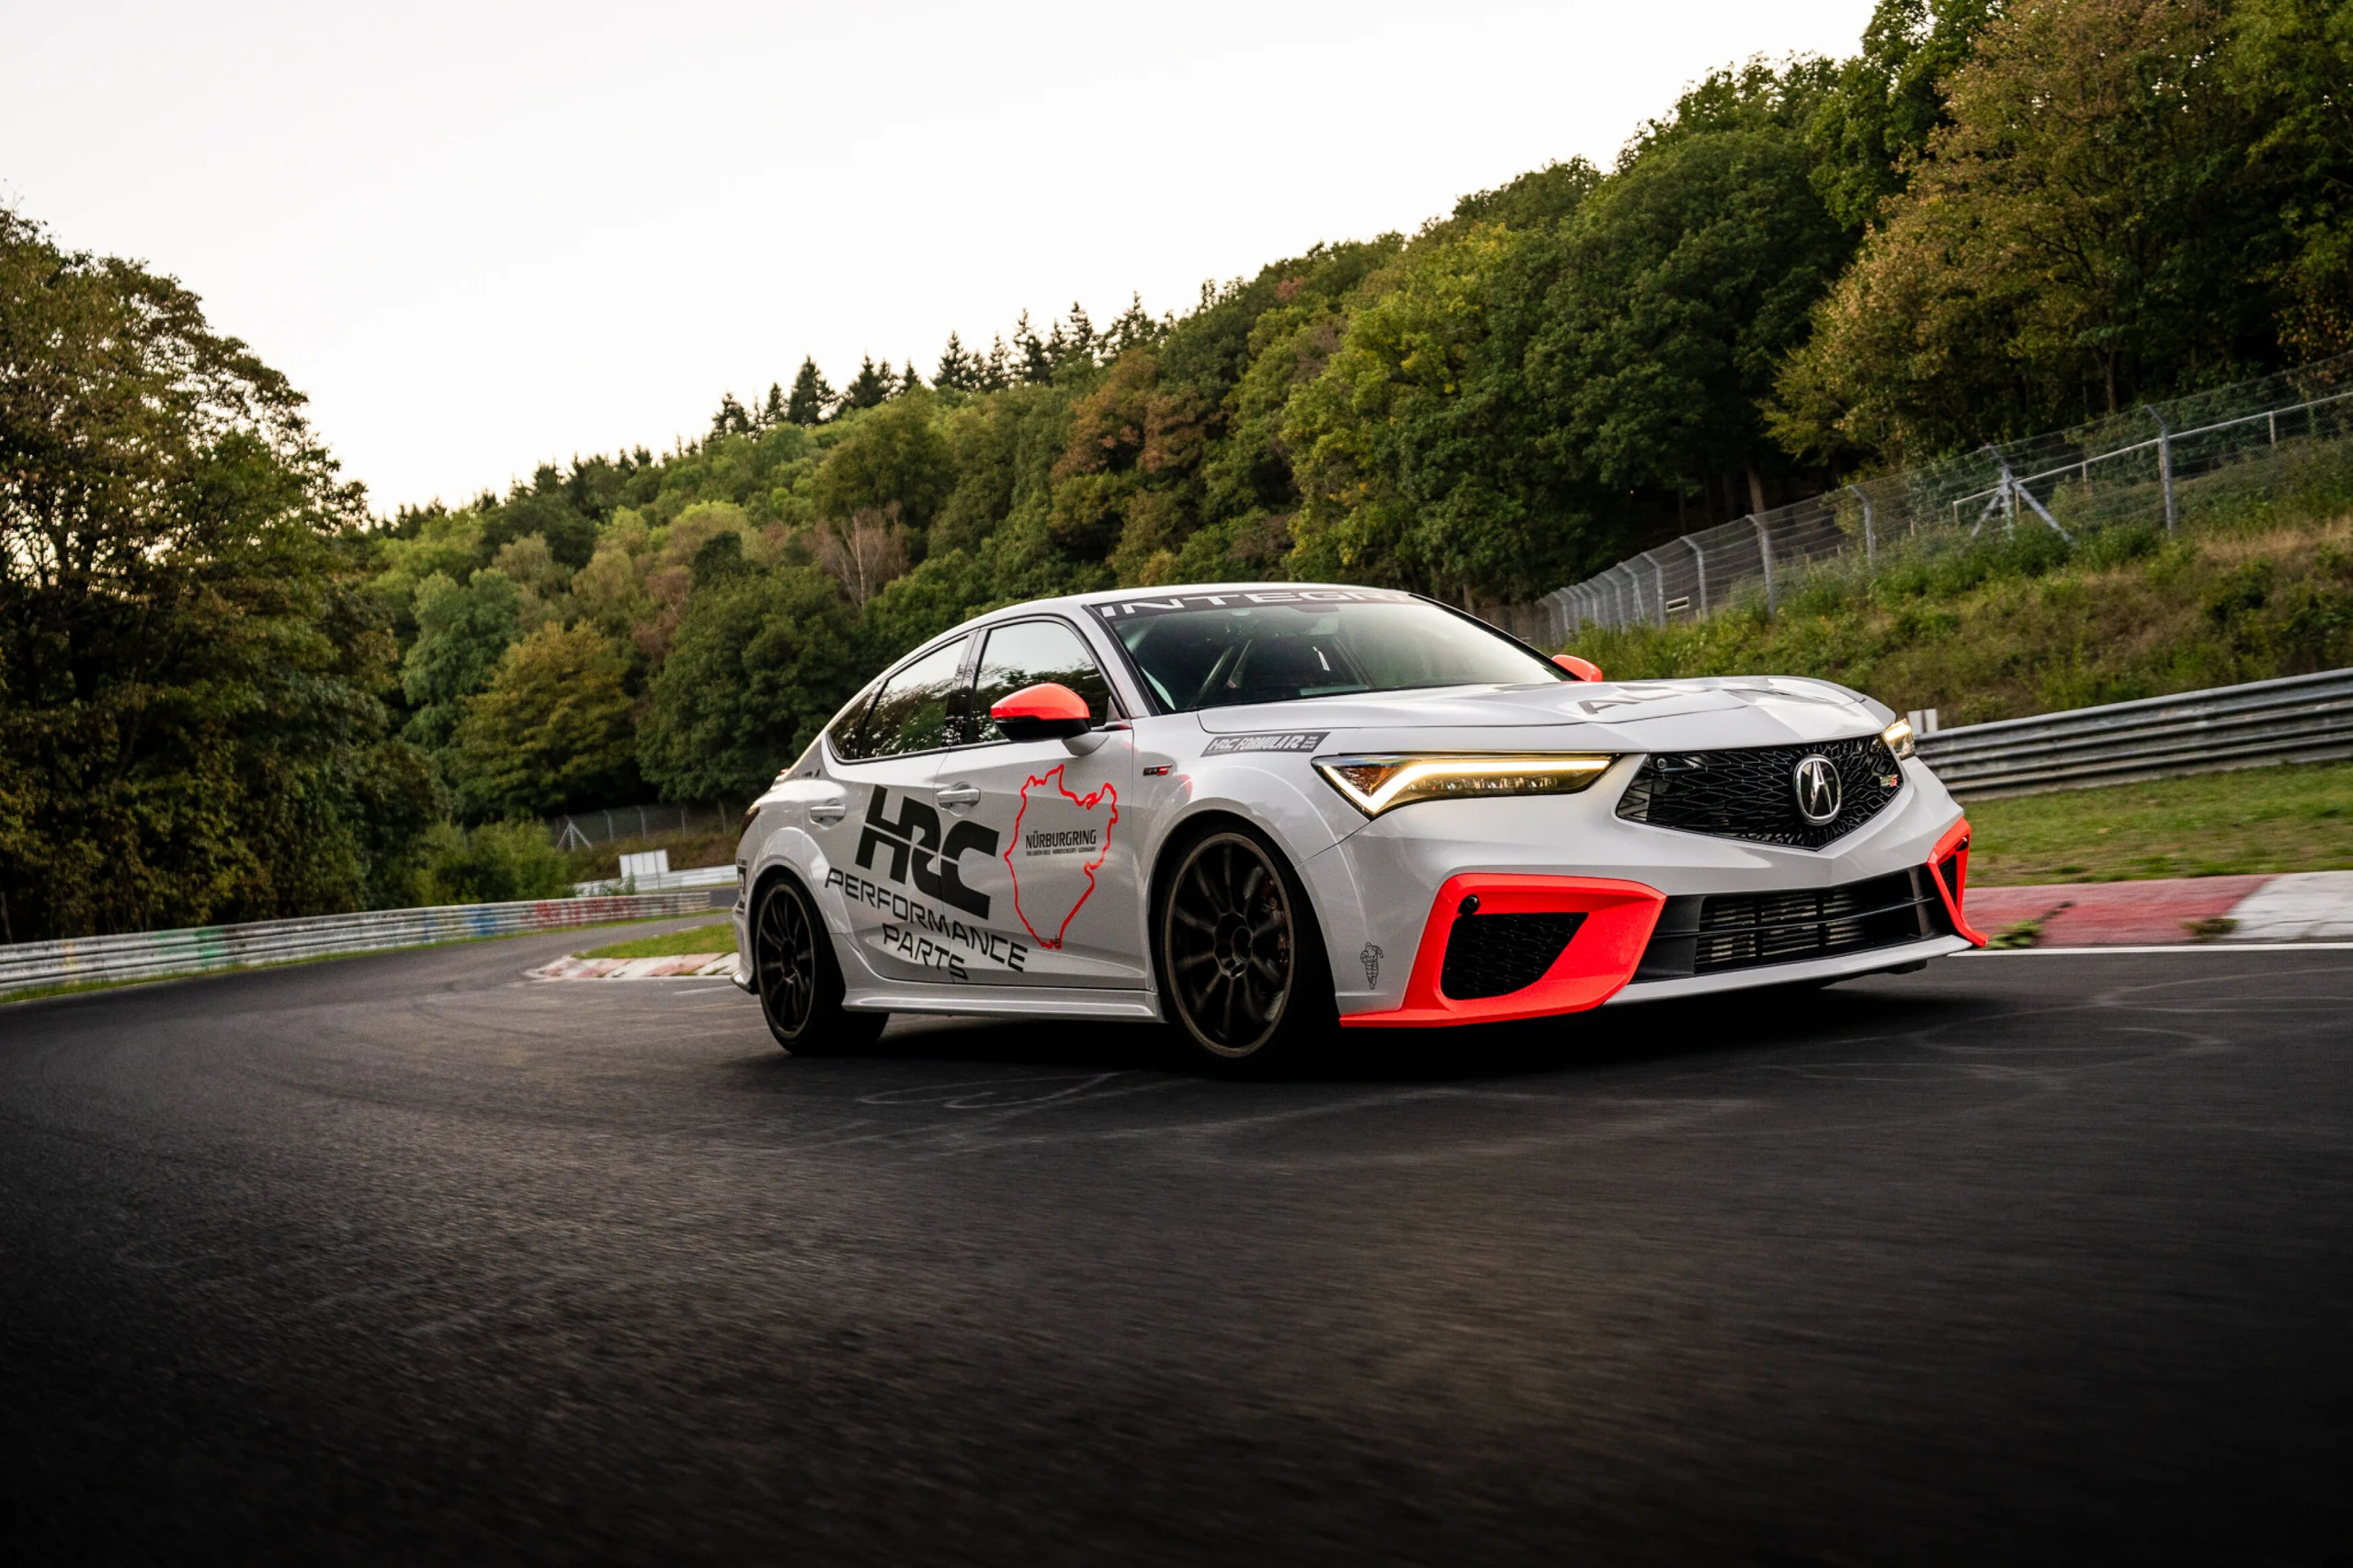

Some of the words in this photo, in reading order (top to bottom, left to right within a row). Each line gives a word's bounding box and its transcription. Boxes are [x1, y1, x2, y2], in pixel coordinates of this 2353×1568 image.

[855, 784, 1000, 920] HRC
[1026, 829, 1097, 848] NÜRBURGRING
[825, 867, 1028, 972] PERFORMANCE
[882, 923, 968, 981] PARTS
